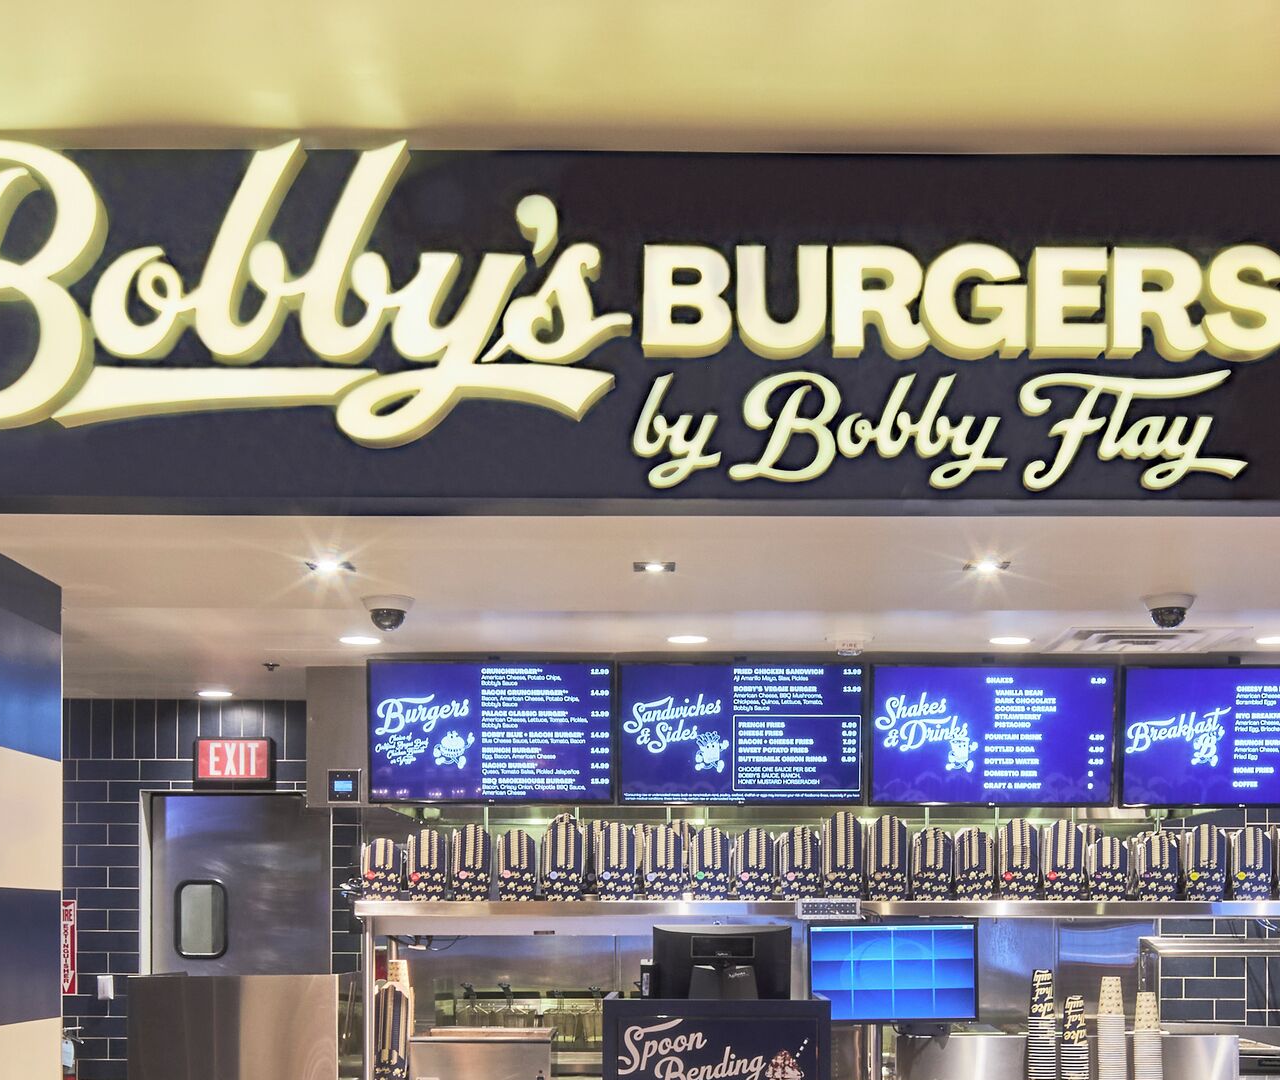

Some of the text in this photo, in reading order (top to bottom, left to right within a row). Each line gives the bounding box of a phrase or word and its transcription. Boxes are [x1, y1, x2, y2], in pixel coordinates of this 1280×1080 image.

[631, 368, 1248, 491] by Bobby Flay
[375, 693, 470, 736] Burgers
[623, 693, 722, 734] Sandwiches
[875, 691, 947, 731] Shakes
[1125, 706, 1232, 753] Breakfast
[636, 719, 698, 753] & Sides
[883, 716, 968, 752] & Drinks
[209, 742, 259, 776] EXIT
[618, 1018, 707, 1076] Spoon
